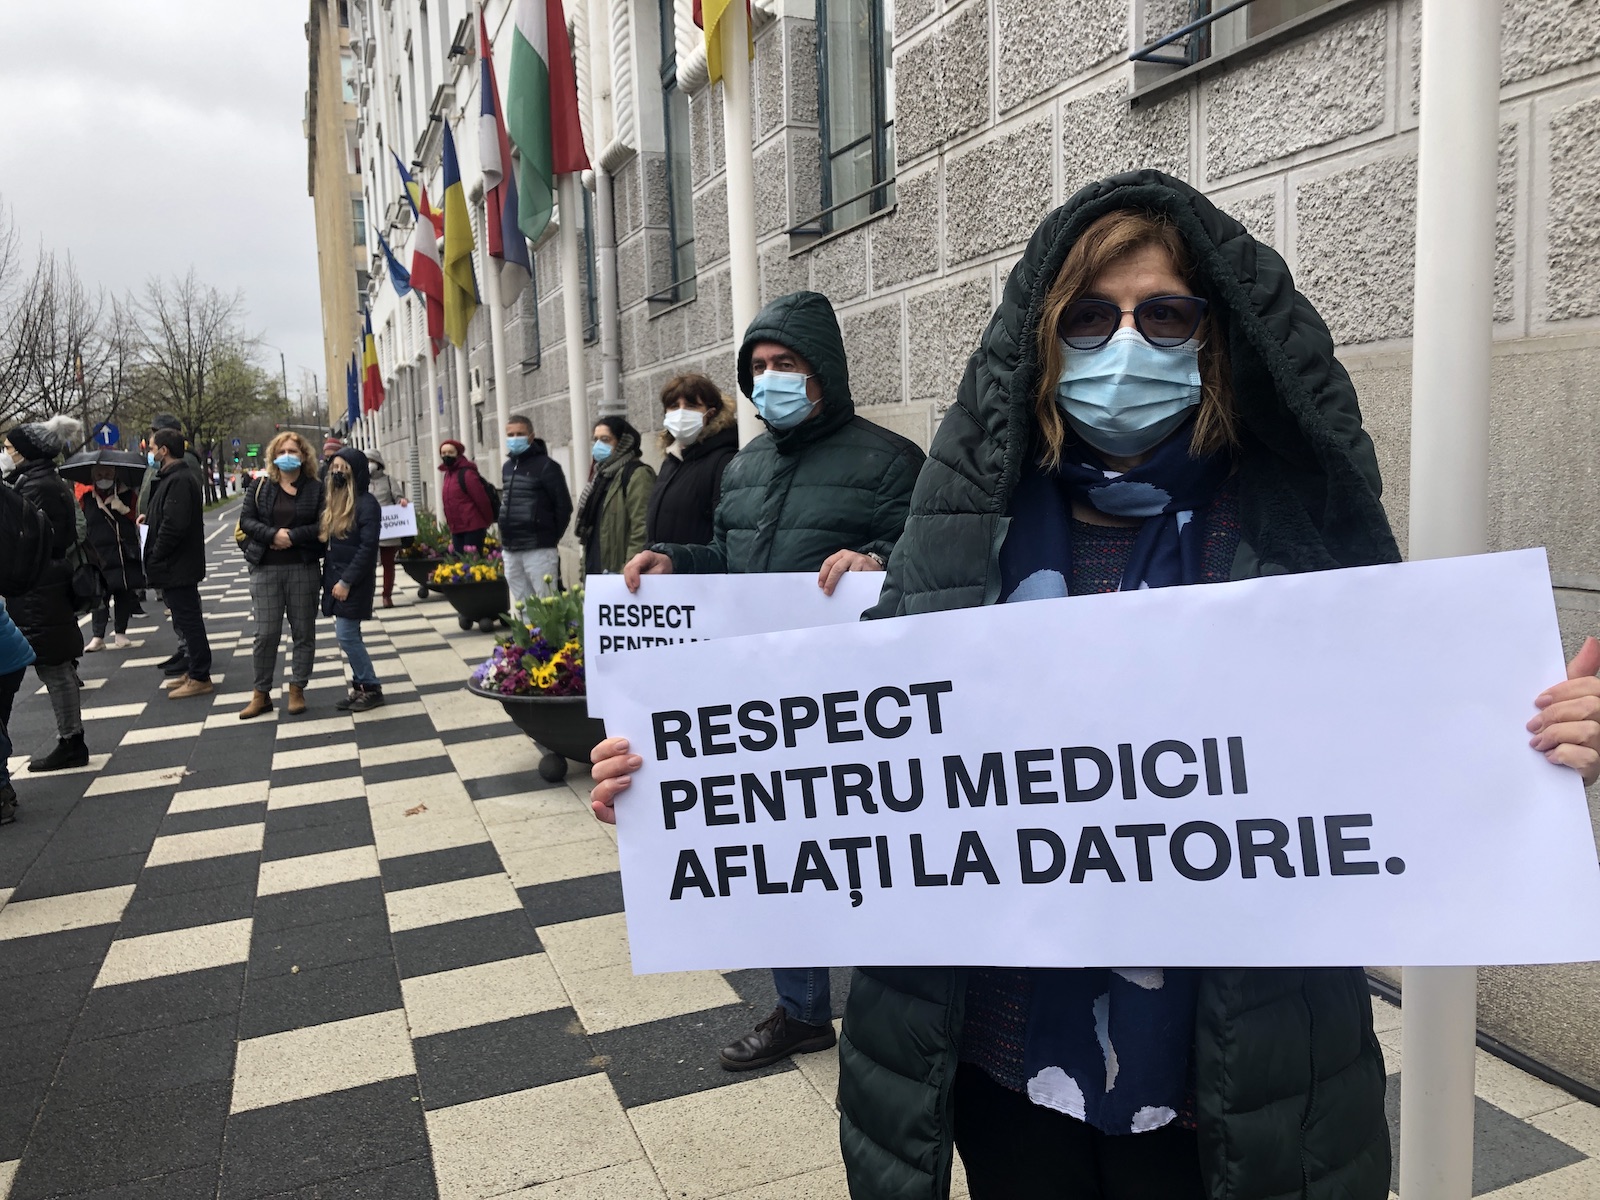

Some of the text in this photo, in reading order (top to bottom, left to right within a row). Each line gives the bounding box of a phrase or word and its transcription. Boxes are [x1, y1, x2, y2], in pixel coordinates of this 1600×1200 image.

[599, 604, 695, 628] RESPECT
[651, 680, 953, 761] RESPECT
[660, 736, 1248, 830] PENTRU MEDICII
[669, 813, 1406, 907] AFLAȚI LA DATORIE.
